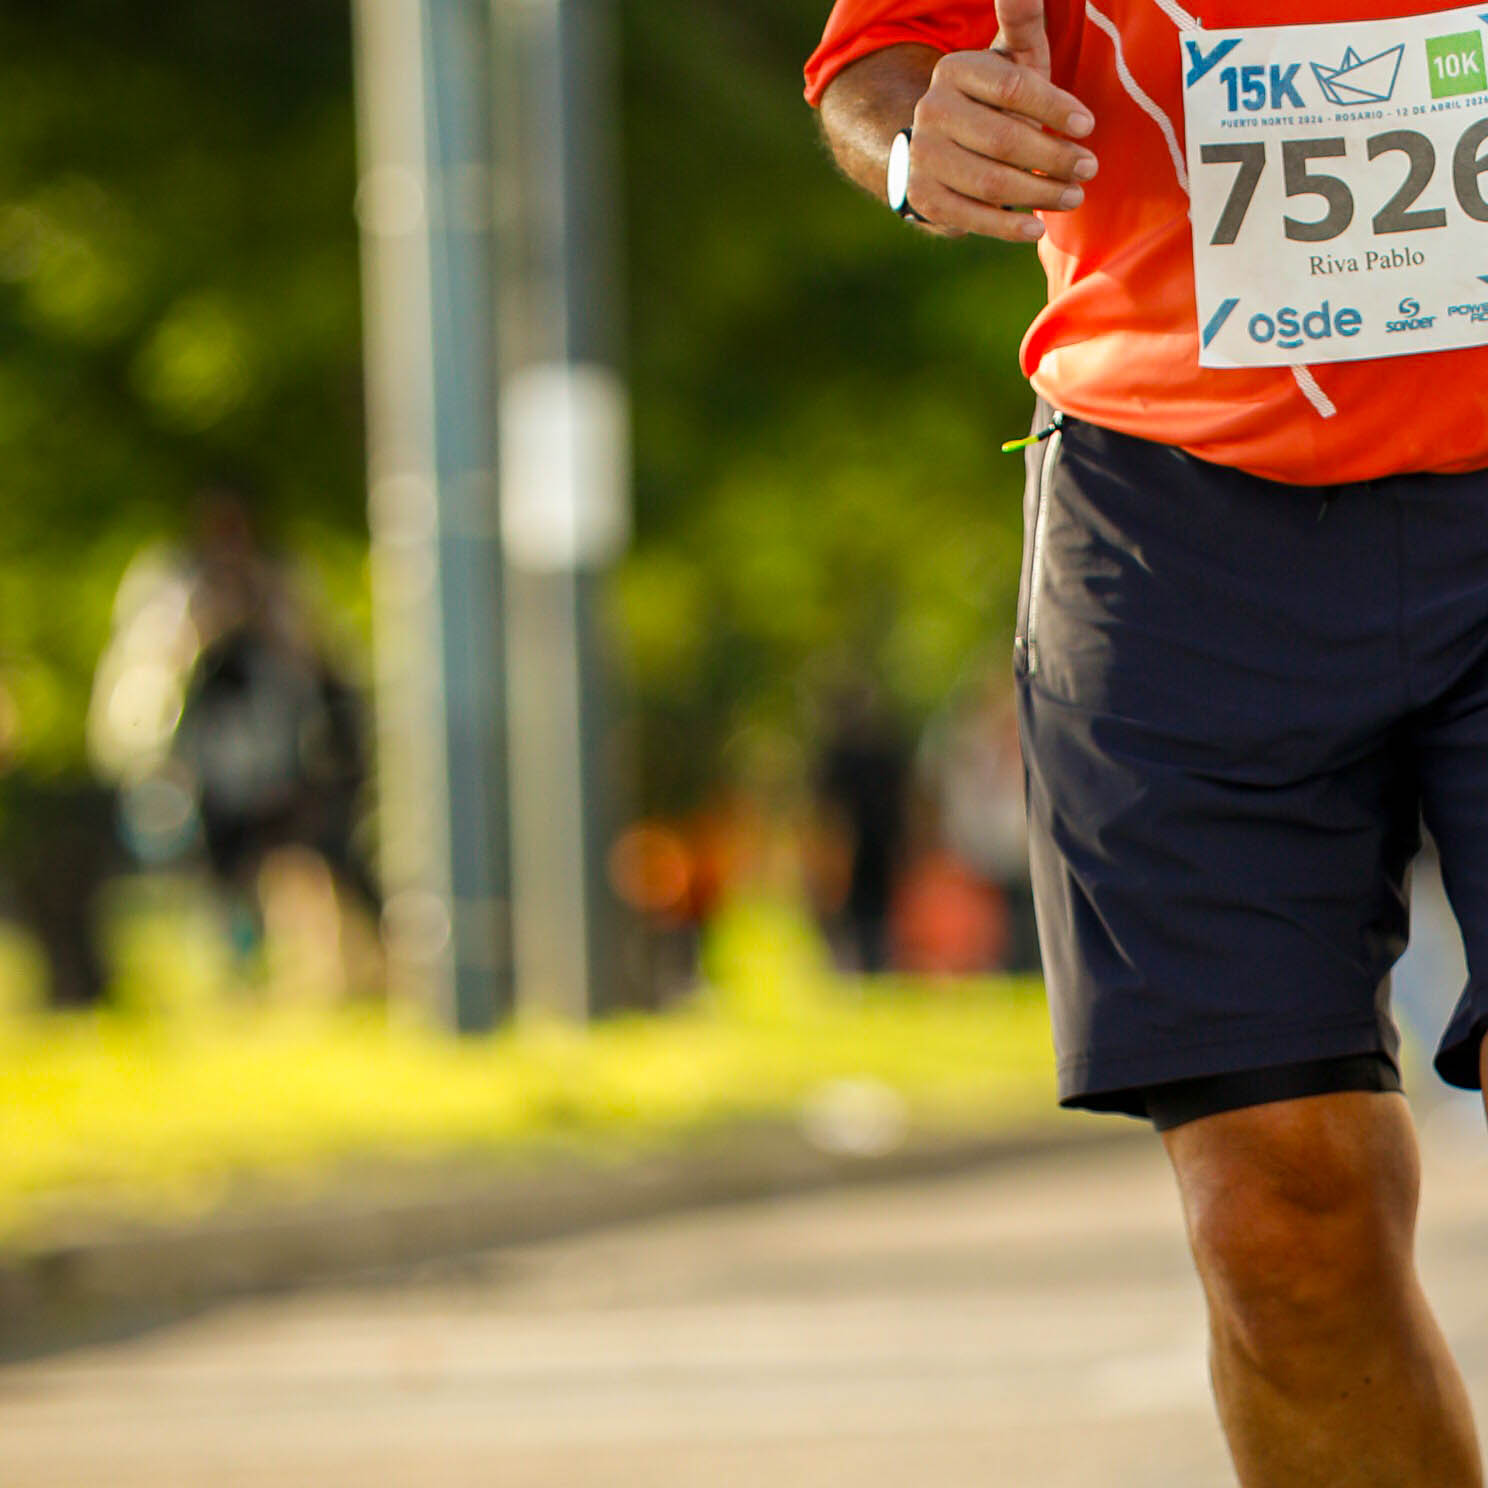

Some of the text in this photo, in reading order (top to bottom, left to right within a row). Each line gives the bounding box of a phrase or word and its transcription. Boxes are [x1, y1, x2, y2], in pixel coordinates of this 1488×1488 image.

[1433, 50, 1481, 80] 10K
[1219, 63, 1306, 113] 15K
[1220, 117, 1258, 129] PUERTO
[1261, 116, 1295, 127] NORTE
[1335, 110, 1384, 122] ROSARIO
[1396, 107, 1409, 118] 12
[1412, 105, 1426, 116] DE
[1430, 100, 1462, 113] ABRIL
[1465, 95, 1488, 108] 2026
[1309, 247, 1425, 276] Riva Pablo
[1248, 300, 1362, 344] osde
